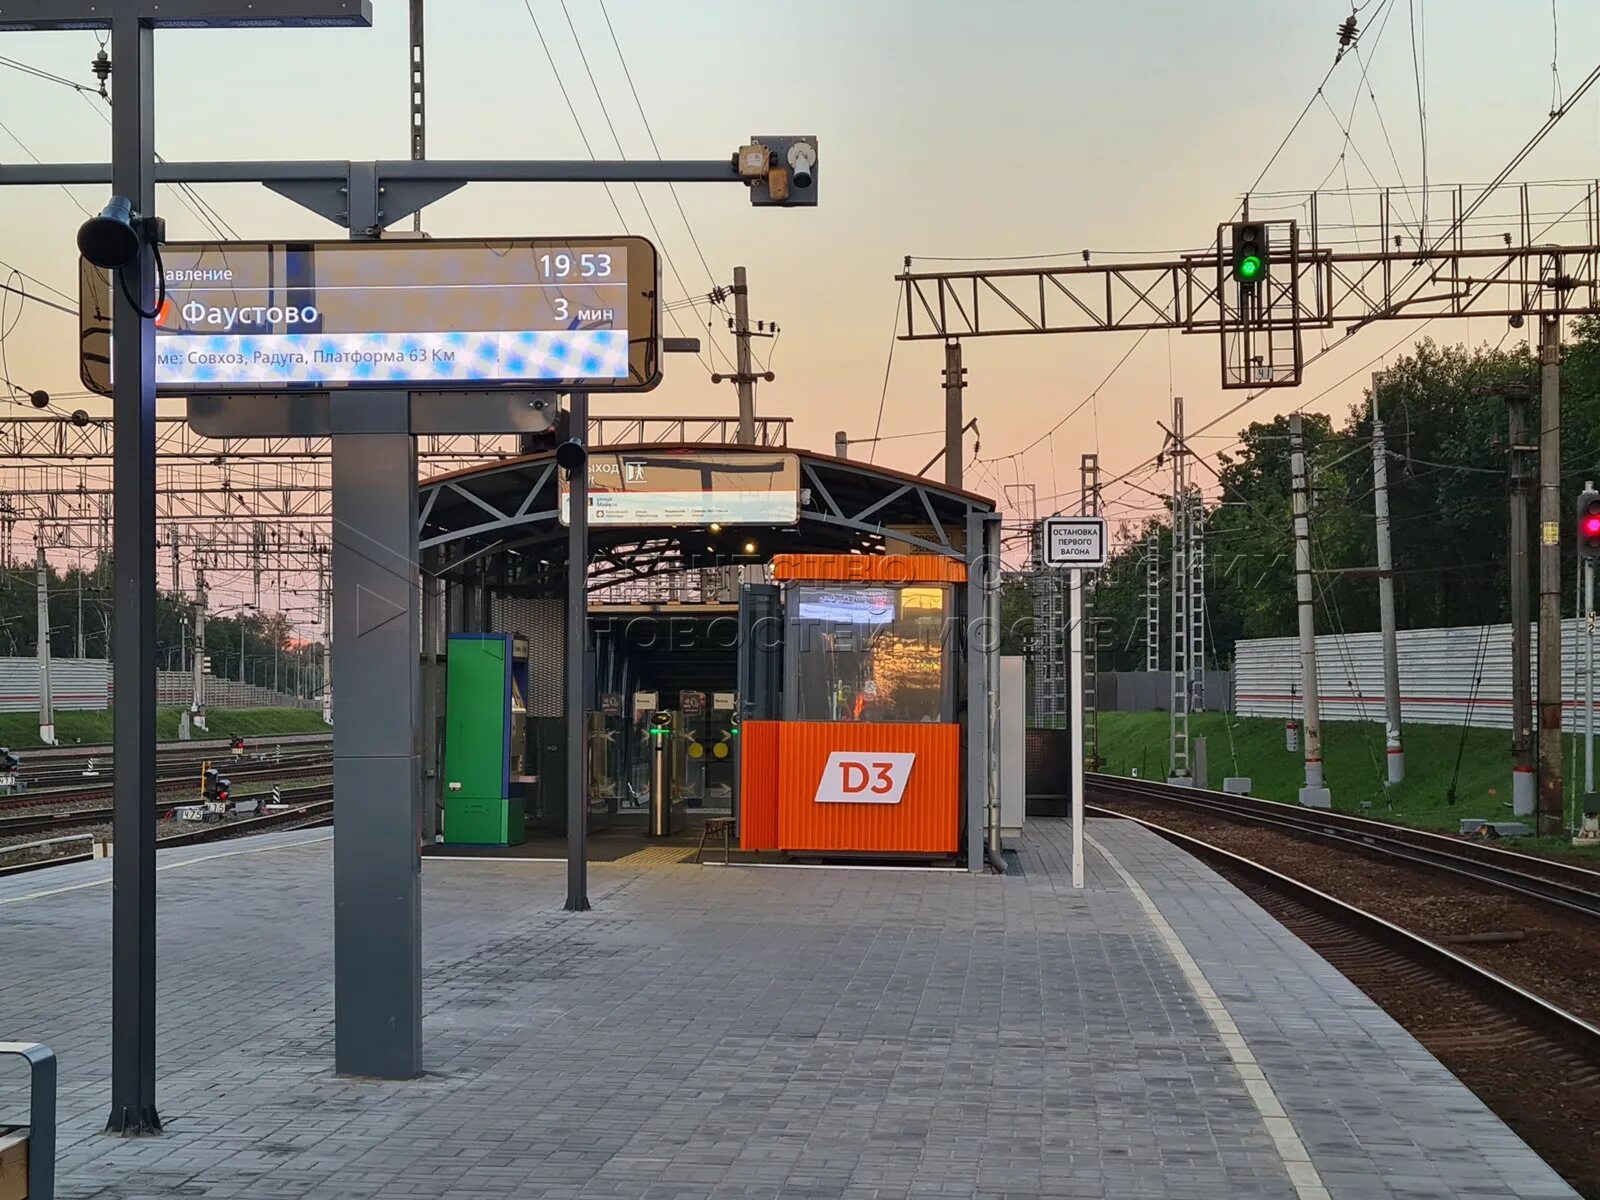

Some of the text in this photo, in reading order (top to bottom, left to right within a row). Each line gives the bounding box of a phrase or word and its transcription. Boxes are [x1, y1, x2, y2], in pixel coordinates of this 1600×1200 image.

[180, 299, 319, 326] Фаустово
[553, 299, 613, 322] 3 мин
[187, 351, 248, 367] Совхоз,
[253, 350, 308, 368] Радуга,
[313, 349, 404, 367] Платформа
[409, 348, 428, 363] 63
[432, 348, 456, 363] Км
[1053, 528, 1098, 536] ОСТАНОВКА
[1058, 538, 1092, 546] ПЕРВОГО
[838, 761, 894, 794] D3
